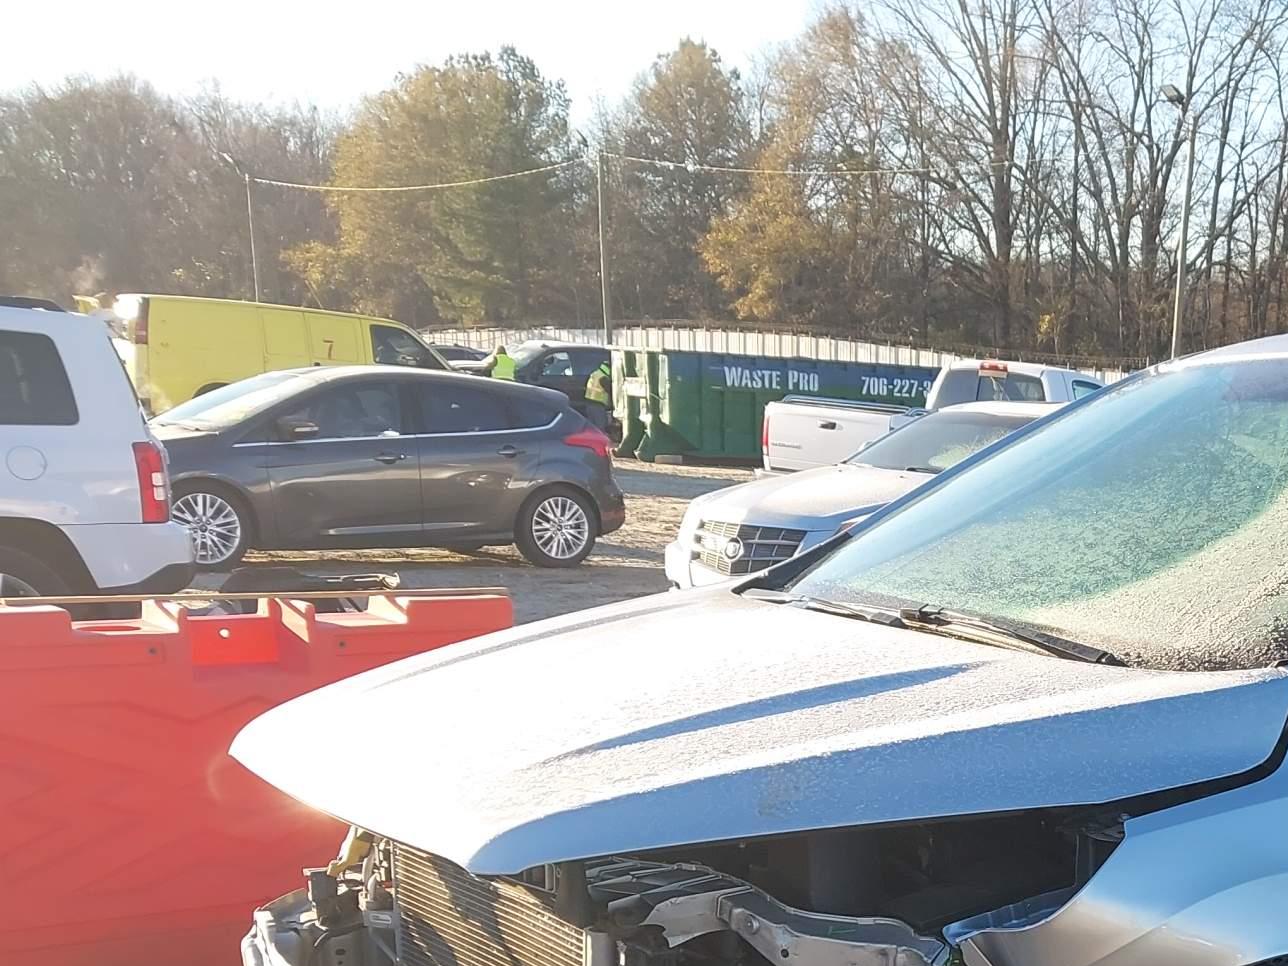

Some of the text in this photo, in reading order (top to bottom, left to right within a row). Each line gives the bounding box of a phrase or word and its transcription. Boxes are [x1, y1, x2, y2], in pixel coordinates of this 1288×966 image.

[323, 339, 334, 360] 7
[723, 366, 819, 392] WASTE PRO
